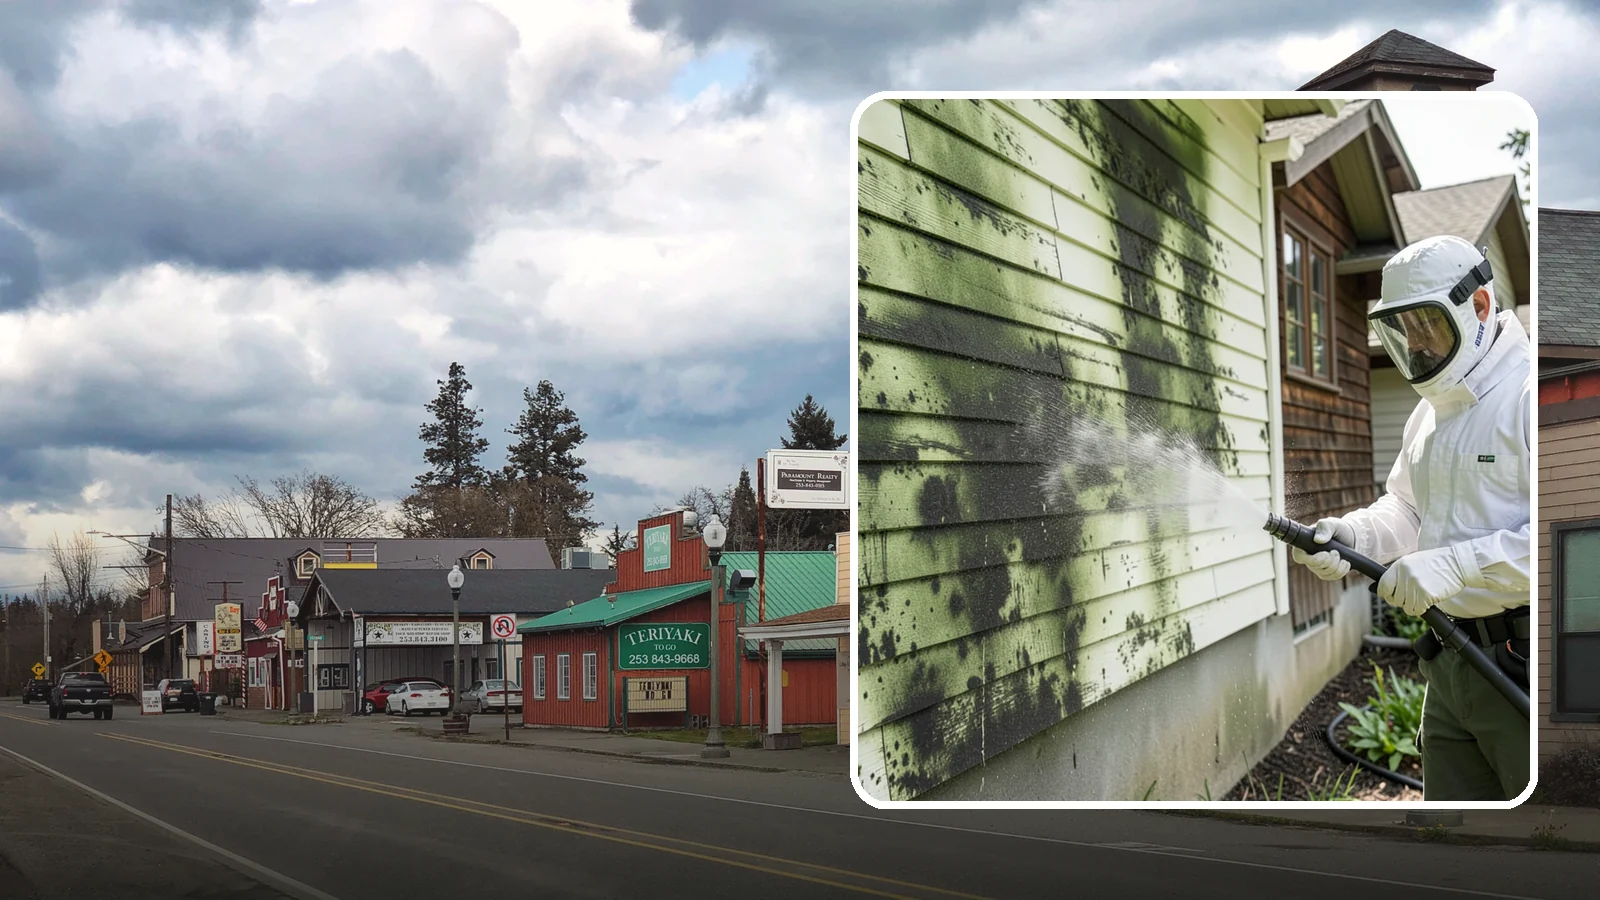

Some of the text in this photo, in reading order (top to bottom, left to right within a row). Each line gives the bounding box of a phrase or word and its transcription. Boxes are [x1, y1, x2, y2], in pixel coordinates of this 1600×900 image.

[625, 628, 702, 646] TERIYAKI
[629, 654, 700, 664] 253 843-9668
